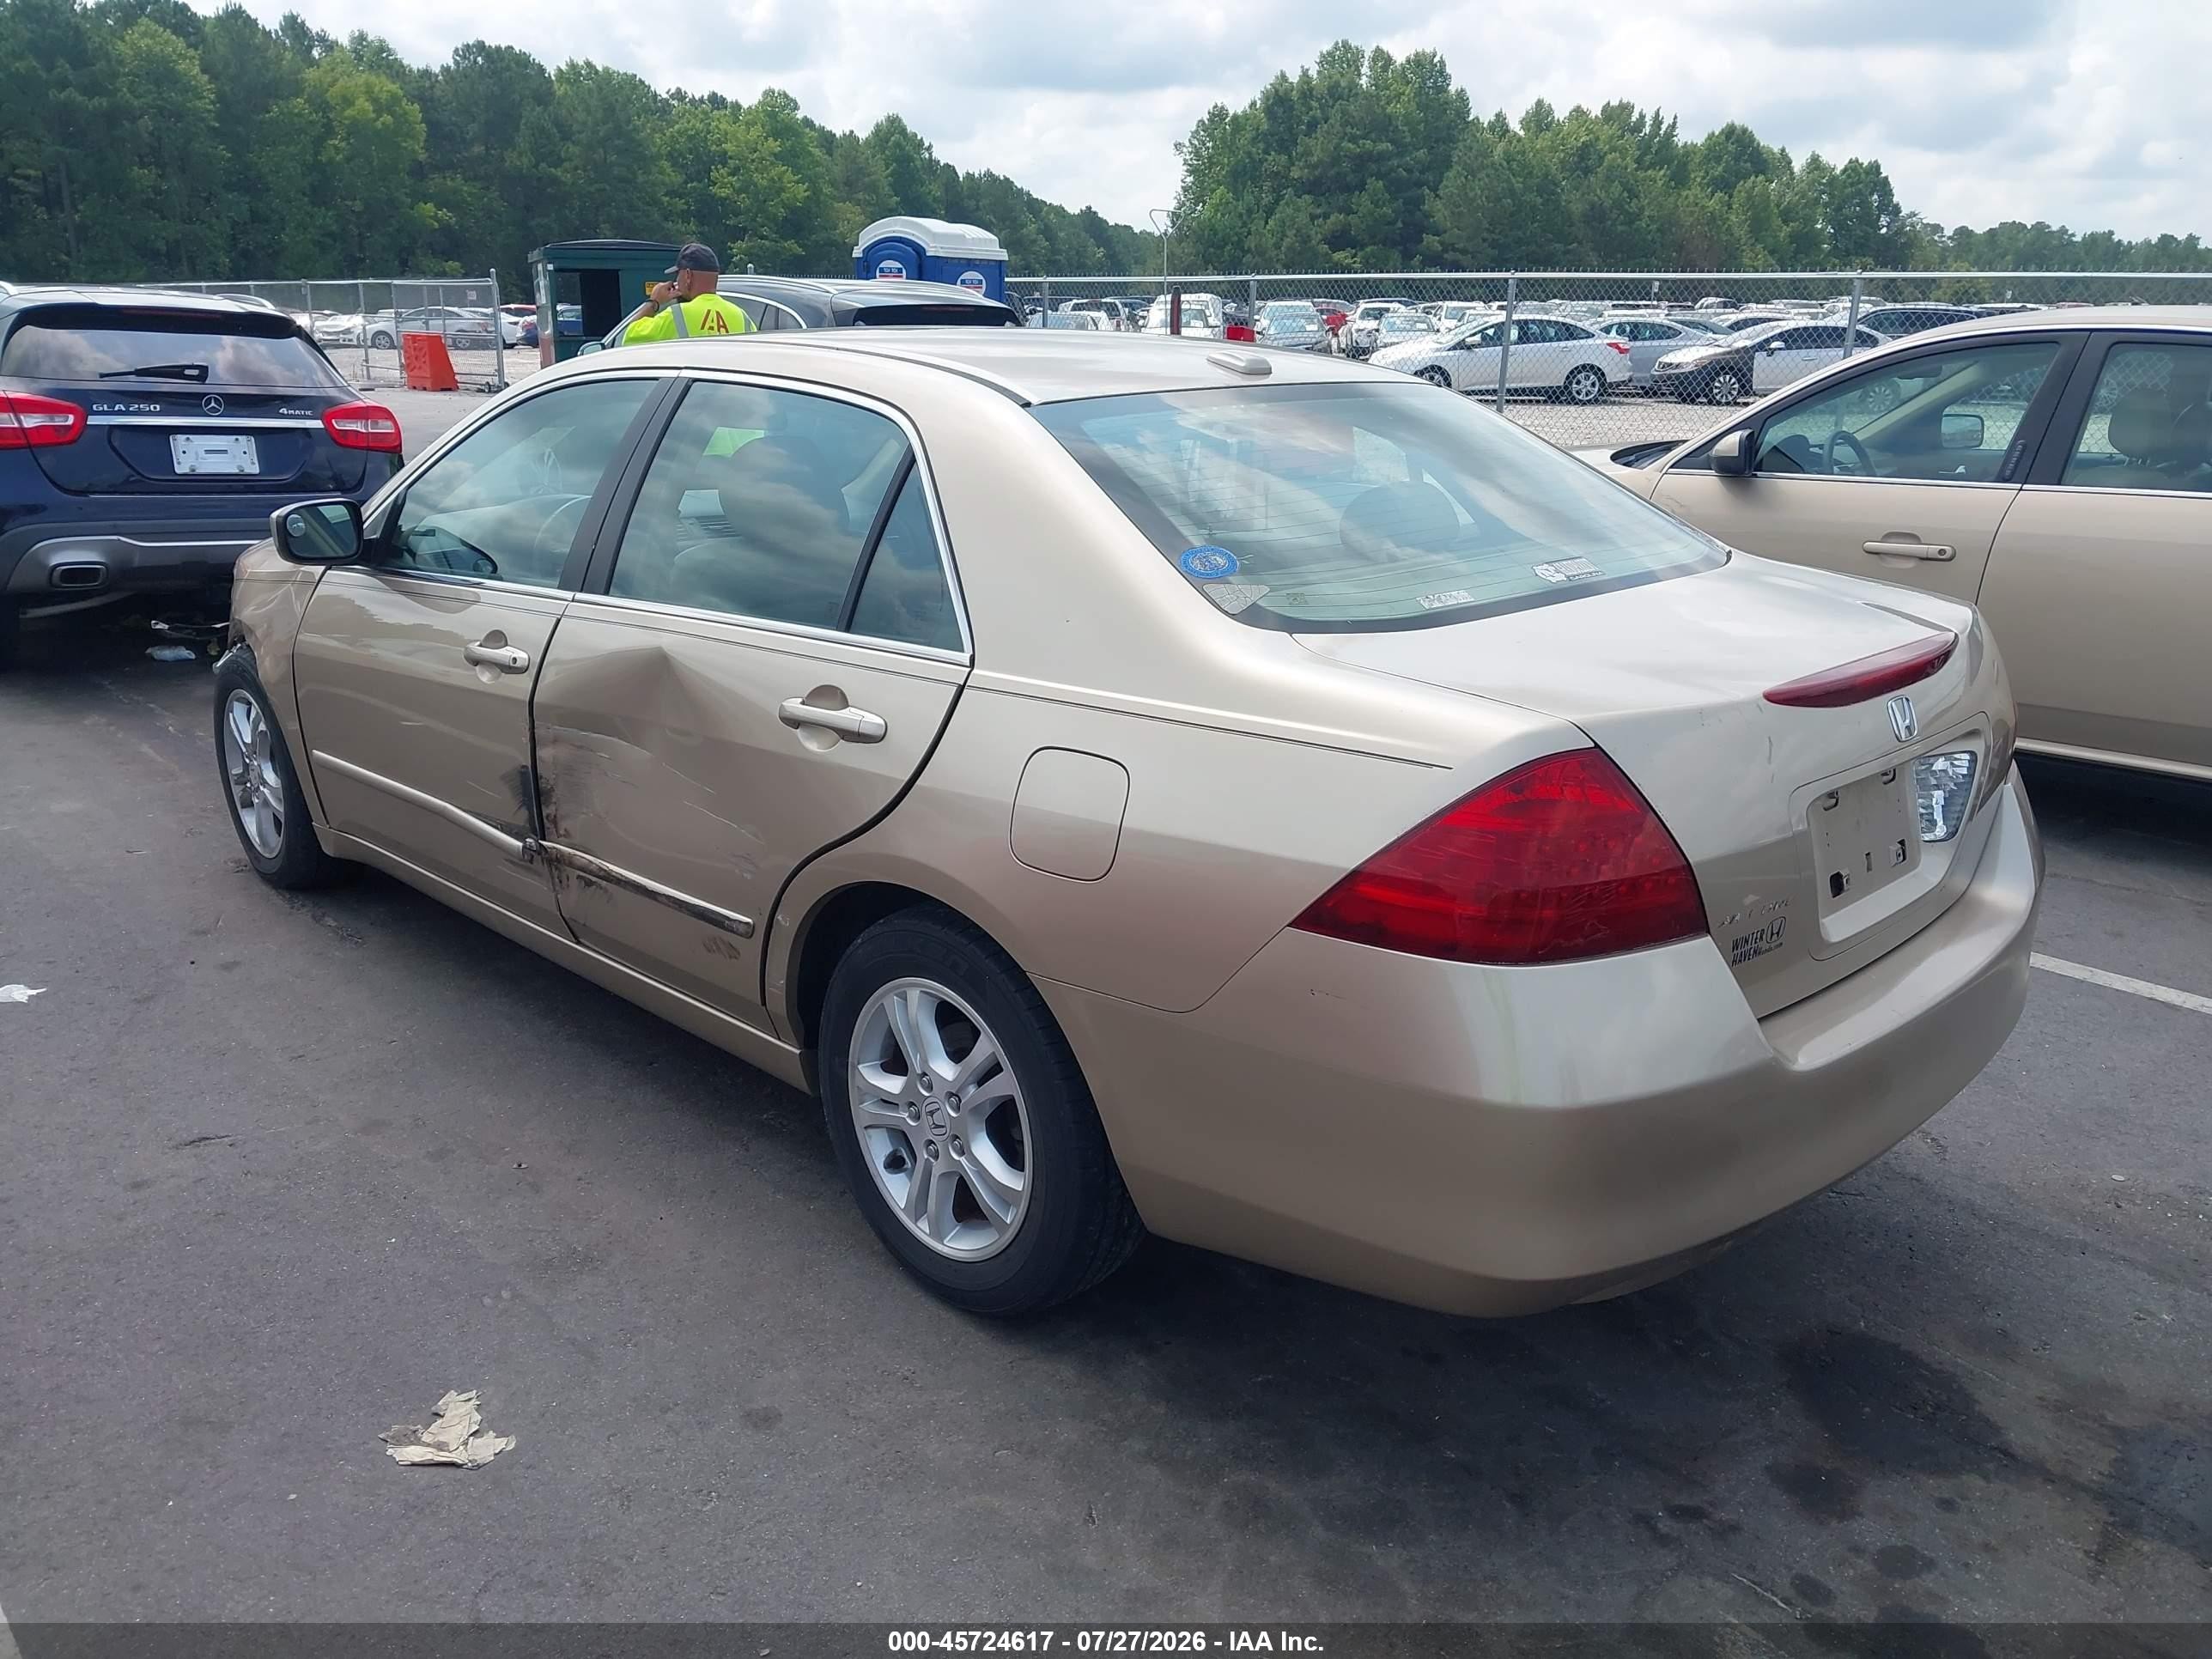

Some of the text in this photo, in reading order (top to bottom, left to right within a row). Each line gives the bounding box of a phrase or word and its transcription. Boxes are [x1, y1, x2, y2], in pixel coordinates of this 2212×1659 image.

[92, 403, 161, 412] GLA 250
[1731, 928, 1765, 953] WINTER
[1731, 945, 1759, 968] HAVEN
